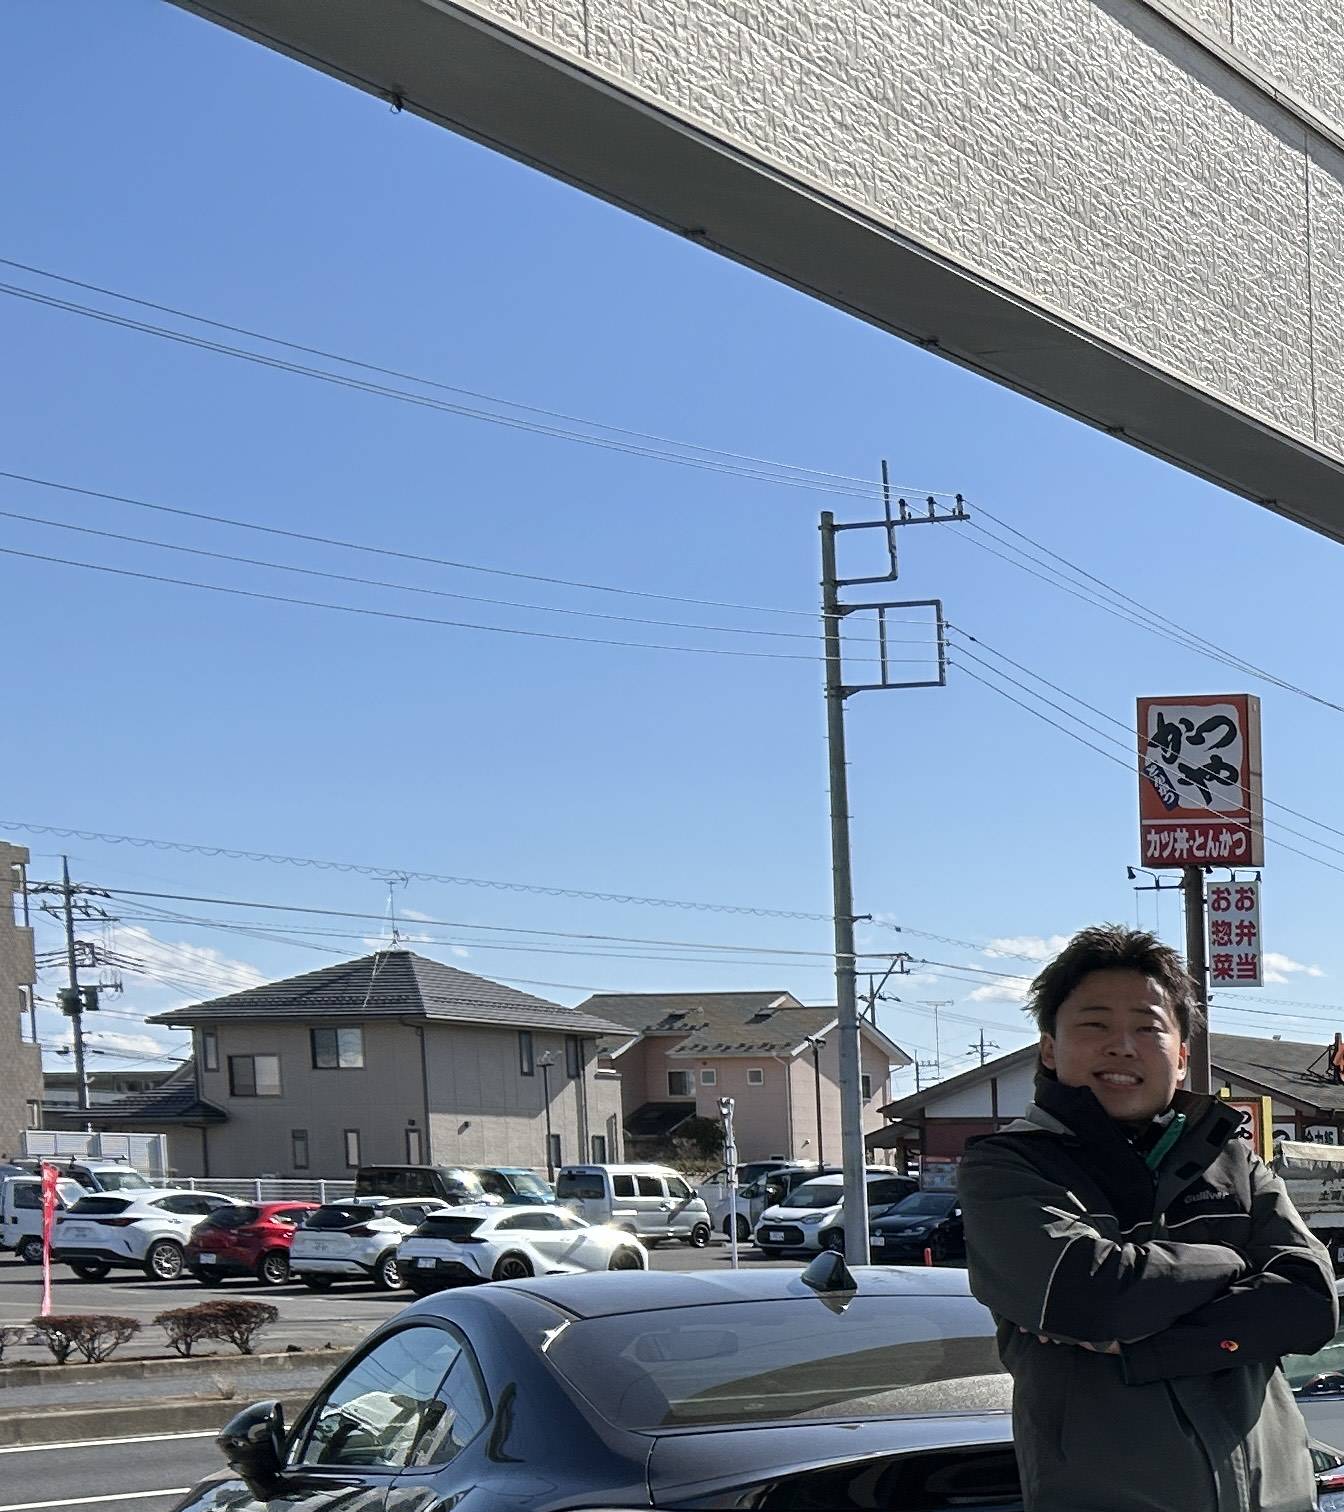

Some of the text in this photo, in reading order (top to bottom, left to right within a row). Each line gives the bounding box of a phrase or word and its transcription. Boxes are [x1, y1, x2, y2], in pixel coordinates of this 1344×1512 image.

[1147, 711, 1239, 806] かつや
[1211, 886, 1235, 980] お惣菜
[1234, 886, 1258, 980] お弁当
